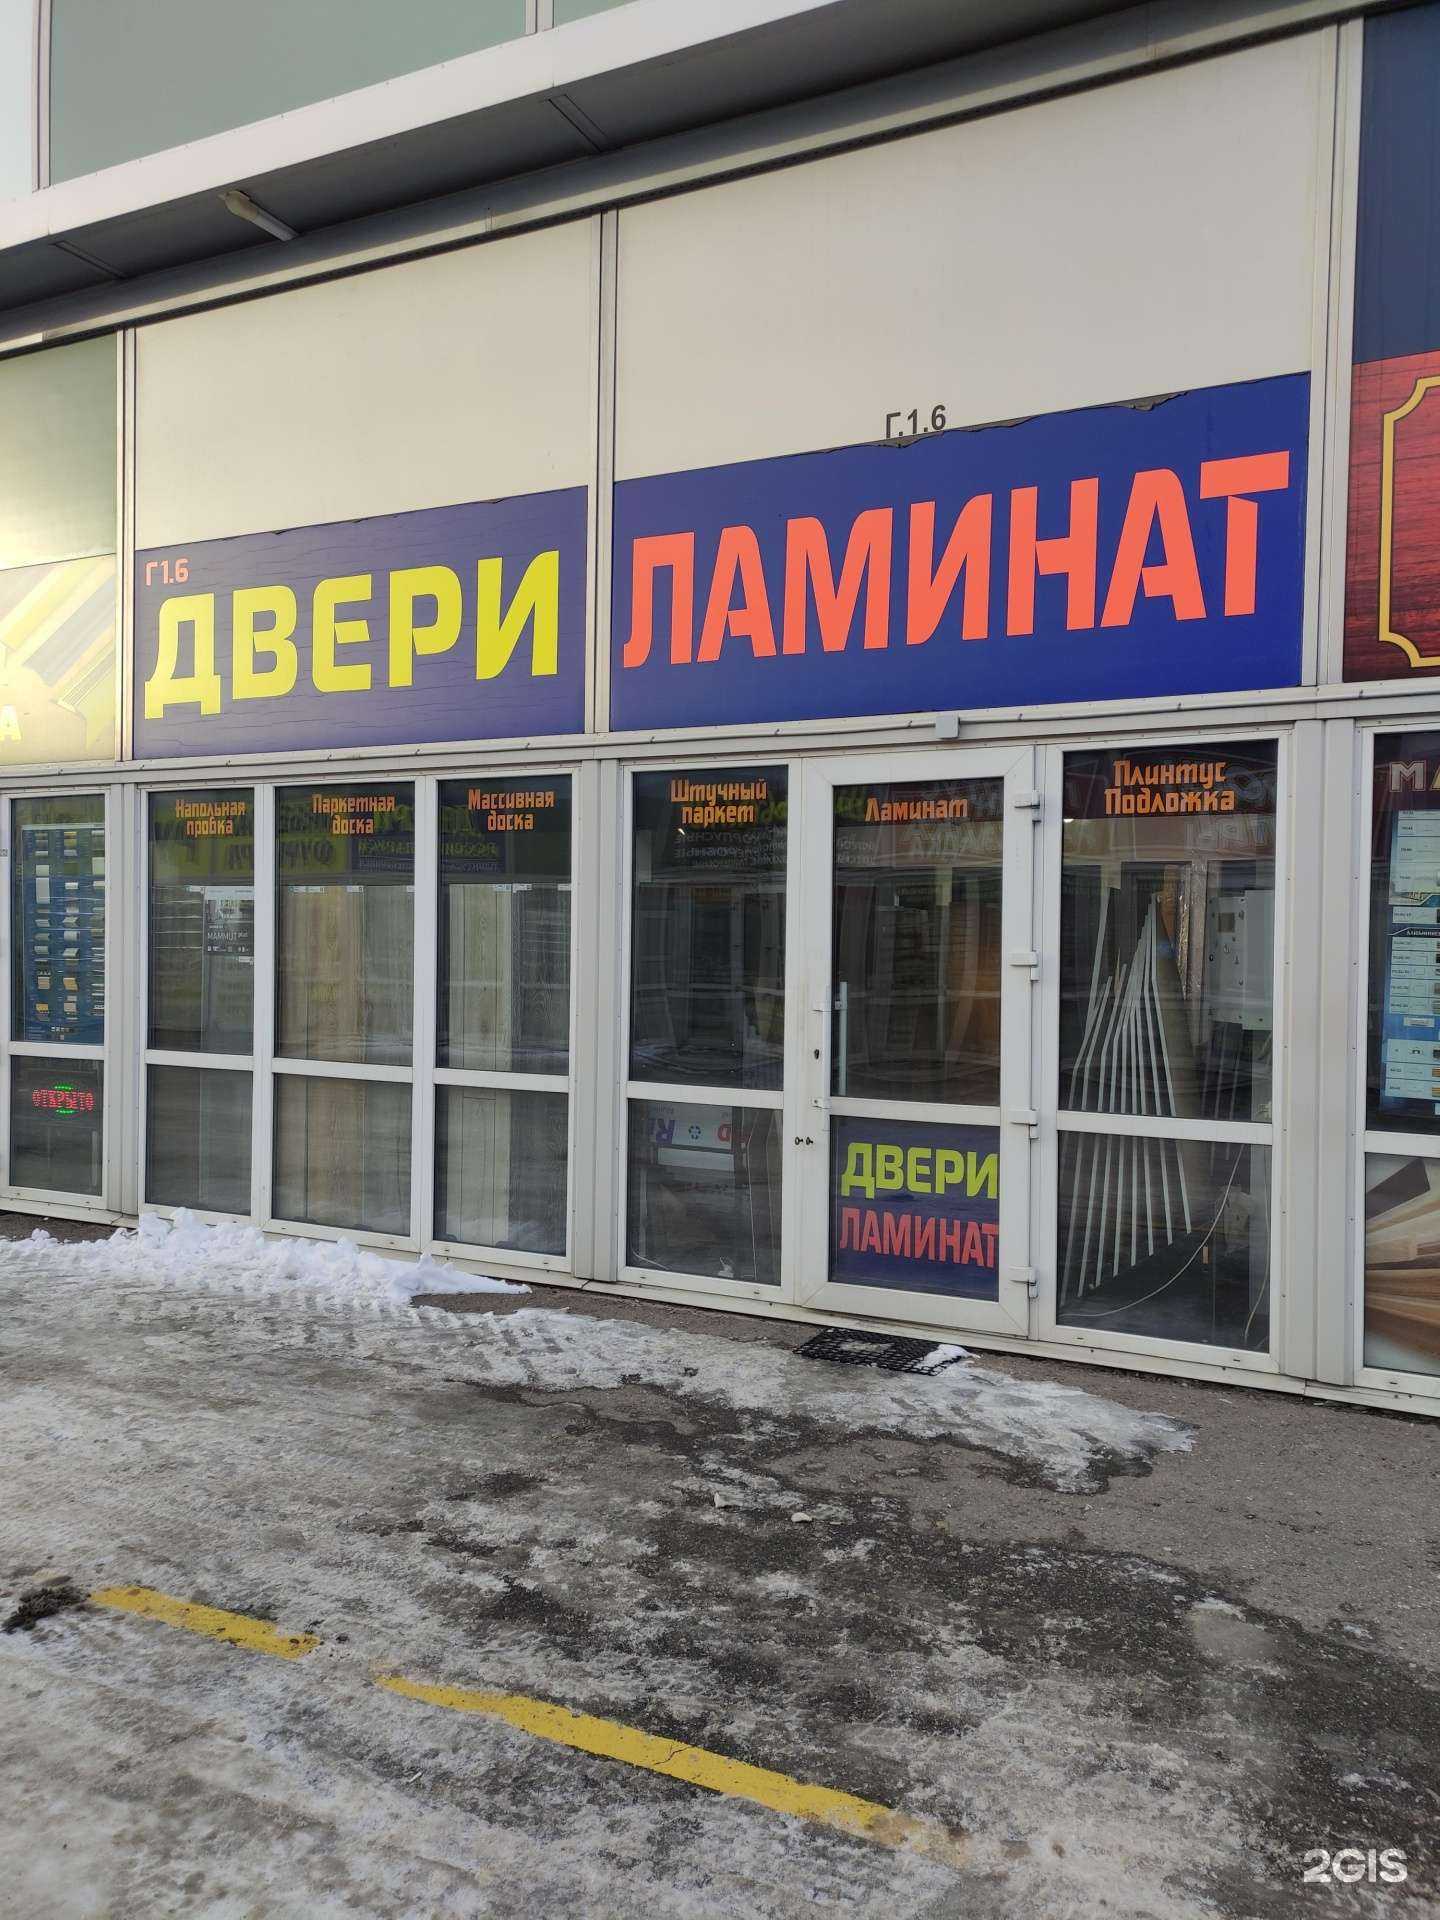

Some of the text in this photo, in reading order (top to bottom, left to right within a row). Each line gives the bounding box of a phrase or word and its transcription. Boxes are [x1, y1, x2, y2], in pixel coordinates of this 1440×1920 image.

[885, 404, 946, 439] Г.1.6
[145, 557, 189, 586] Г1.6
[623, 450, 1290, 668] ЛАМИНАТ
[144, 550, 560, 720] ДВЕРИ
[1113, 760, 1227, 789] Плинтус
[468, 789, 555, 811] Массивная
[670, 778, 768, 802] Штучный
[1104, 787, 1235, 815] Подложка
[175, 799, 246, 818] Напольная
[312, 794, 396, 815] Паркетная
[681, 803, 755, 828] паркет
[864, 797, 969, 822] Ламинат
[186, 817, 234, 837] пробка
[332, 815, 375, 835] доска
[487, 810, 534, 831] доска
[840, 1142, 999, 1199] ДВЕРИ
[840, 1206, 999, 1268] ЛАМИНАТ
